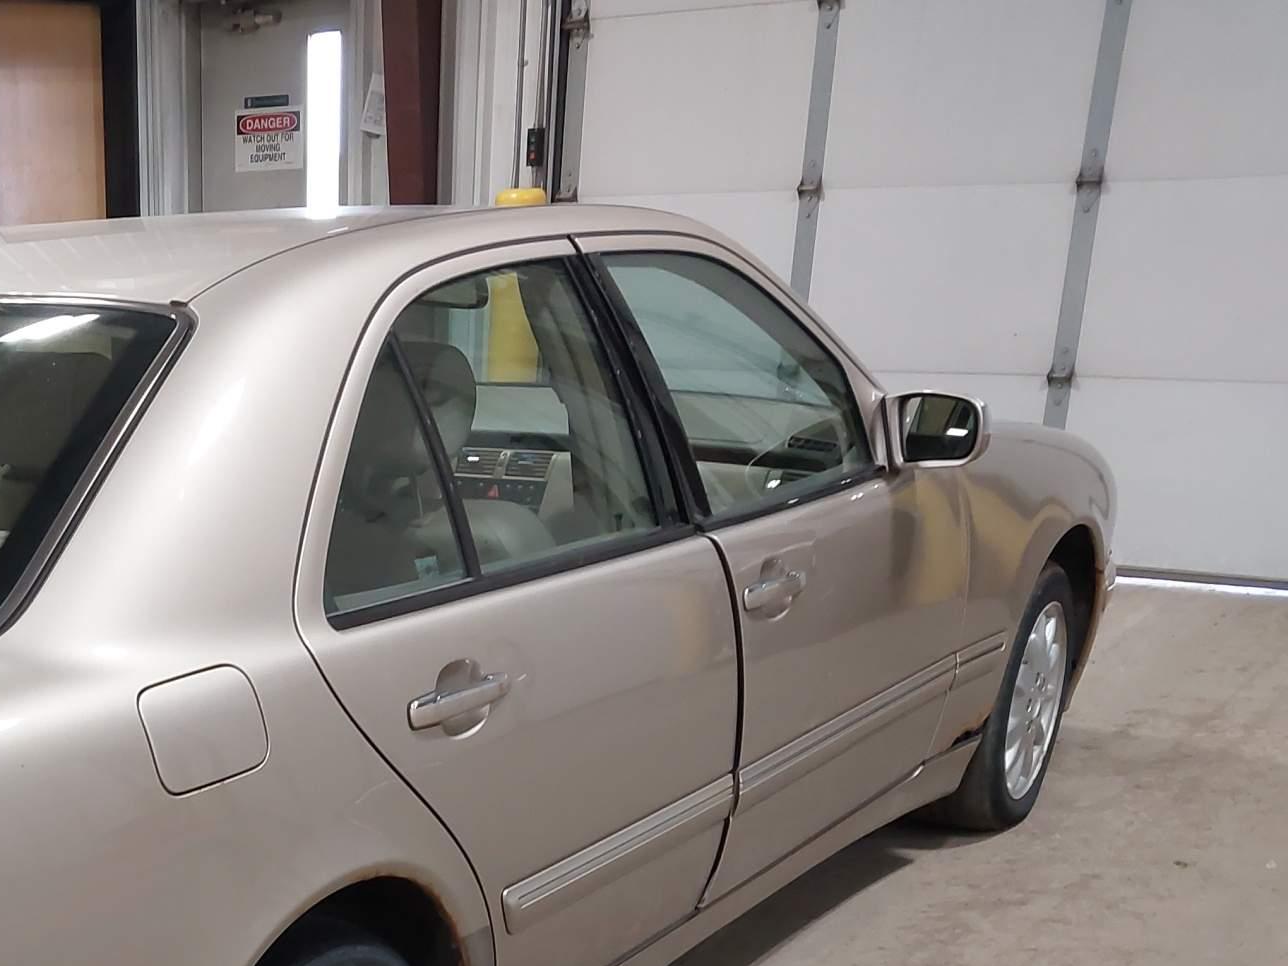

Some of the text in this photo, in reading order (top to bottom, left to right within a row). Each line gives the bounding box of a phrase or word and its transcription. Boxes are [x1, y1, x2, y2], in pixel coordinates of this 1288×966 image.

[246, 116, 290, 130] DANGER
[242, 132, 294, 144] WATCH OUT FOR
[255, 143, 280, 153] MOVING
[250, 152, 286, 163] EQUIPMENT
